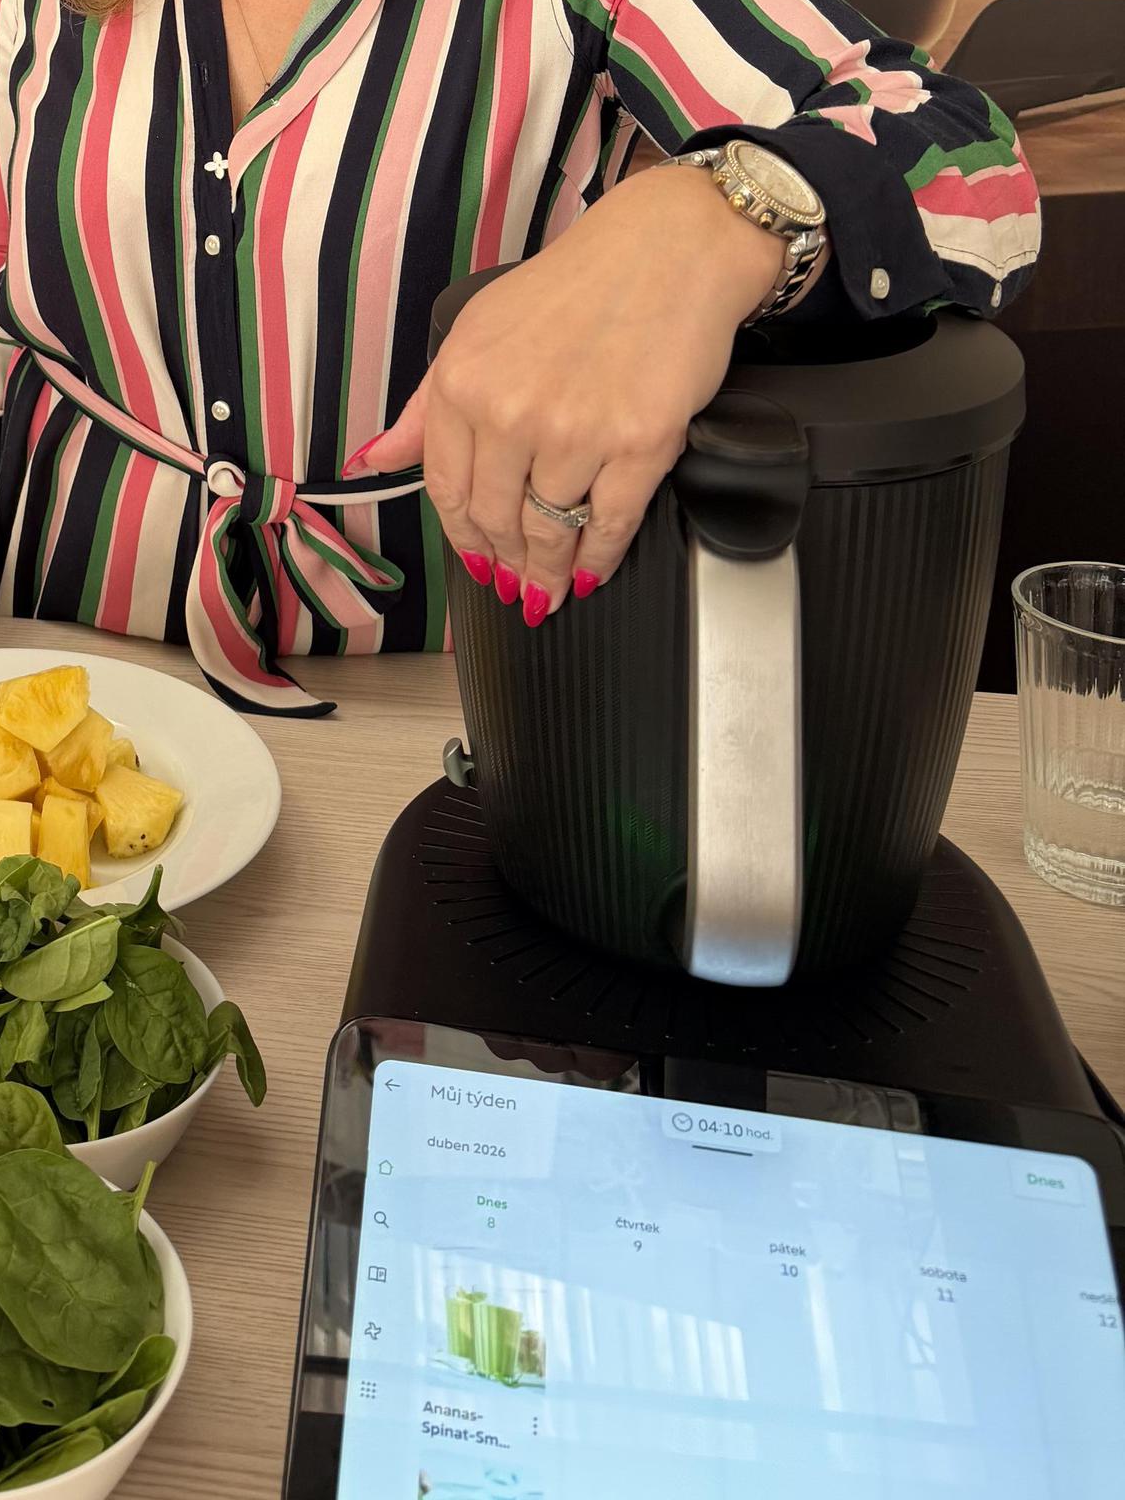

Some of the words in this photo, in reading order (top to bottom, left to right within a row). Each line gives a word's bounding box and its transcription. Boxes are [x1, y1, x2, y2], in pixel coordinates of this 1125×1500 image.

[431, 1085, 462, 1106] Můj
[466, 1090, 517, 1110] týden
[698, 1118, 743, 1138] 04:10
[746, 1126, 775, 1141] hod.
[427, 1136, 470, 1152] duben
[473, 1142, 507, 1158] 2026
[1027, 1172, 1065, 1190] Dnes
[476, 1195, 508, 1210] Dnes
[487, 1216, 496, 1229] 8
[615, 1216, 660, 1234] čtvrtek
[633, 1240, 642, 1252] 9
[780, 1263, 799, 1278] 10
[937, 1287, 955, 1303] 11
[1098, 1313, 1118, 1329] 12
[423, 1400, 483, 1422] Ananas-
